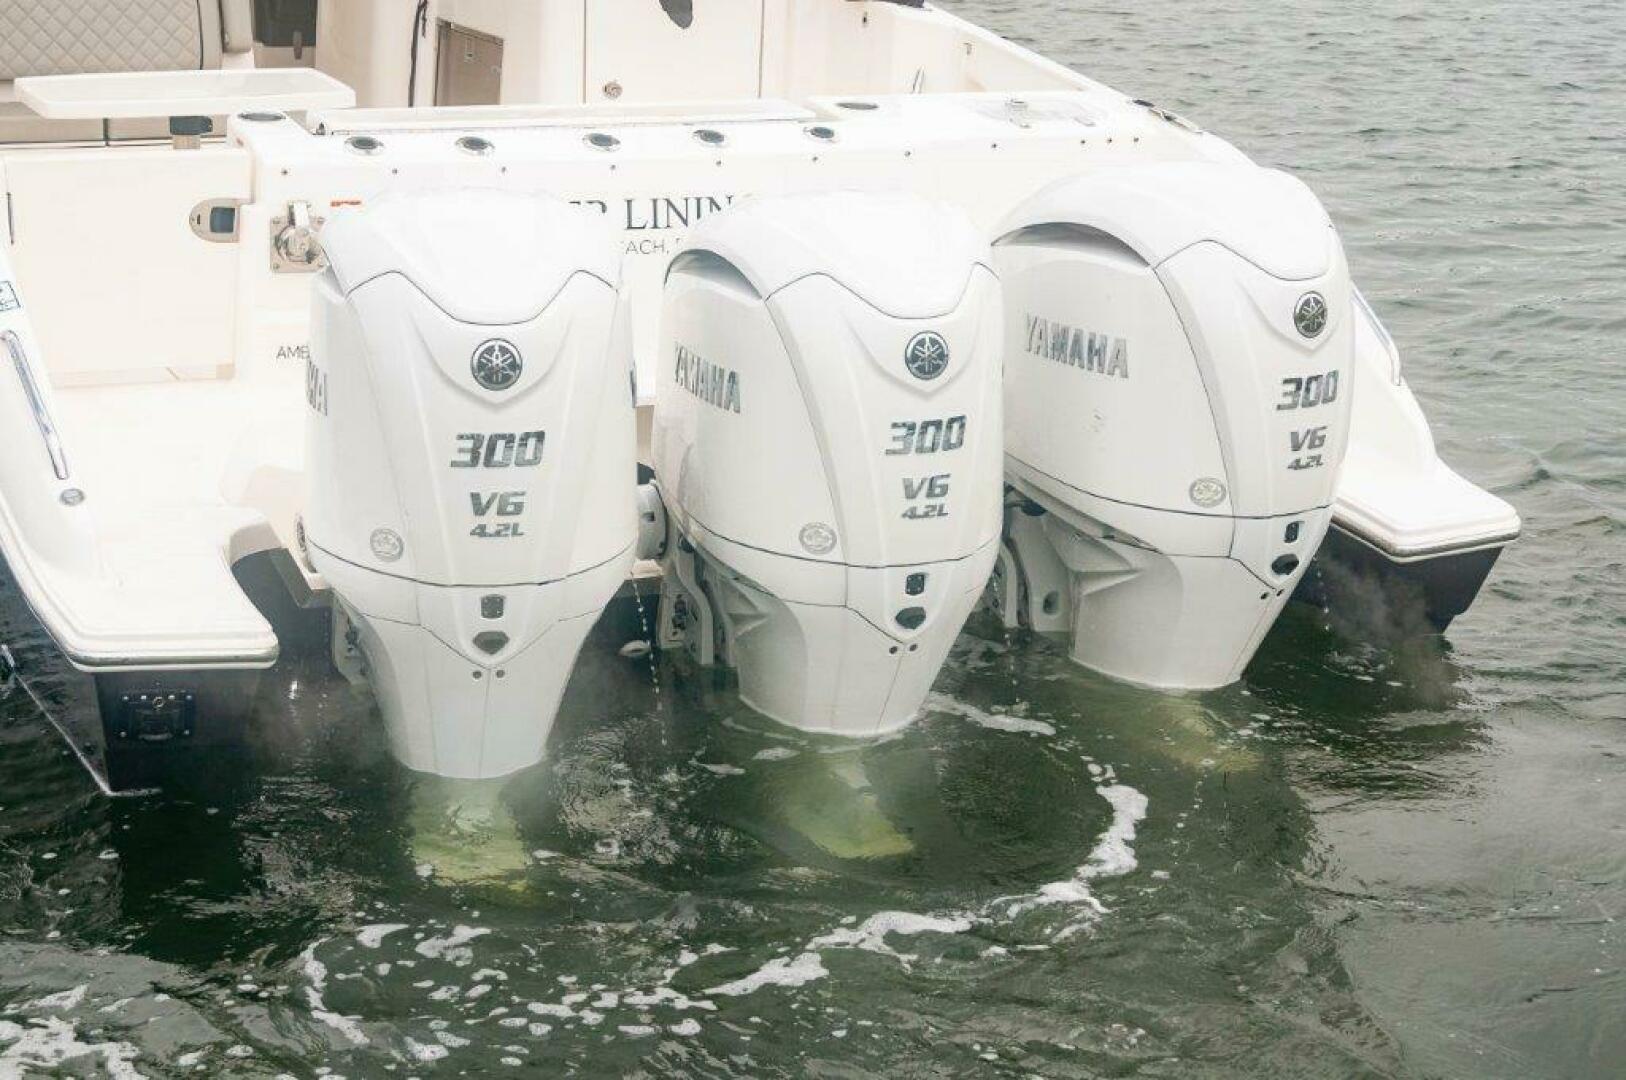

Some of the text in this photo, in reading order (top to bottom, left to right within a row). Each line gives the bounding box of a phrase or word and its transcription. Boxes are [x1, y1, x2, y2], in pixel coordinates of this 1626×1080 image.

[619, 239, 670, 254] ACH,
[1025, 312, 1129, 379] YAMAHA
[674, 341, 741, 414] YAMAHA
[1276, 370, 1339, 410] 300
[885, 415, 967, 455] 300
[1290, 425, 1328, 452] V6
[450, 430, 545, 468] 300
[1286, 453, 1324, 471] 4.2L
[902, 473, 951, 500] V6
[469, 491, 526, 517] V6
[901, 503, 949, 520] 4.2L
[469, 522, 525, 538] 4.2L
